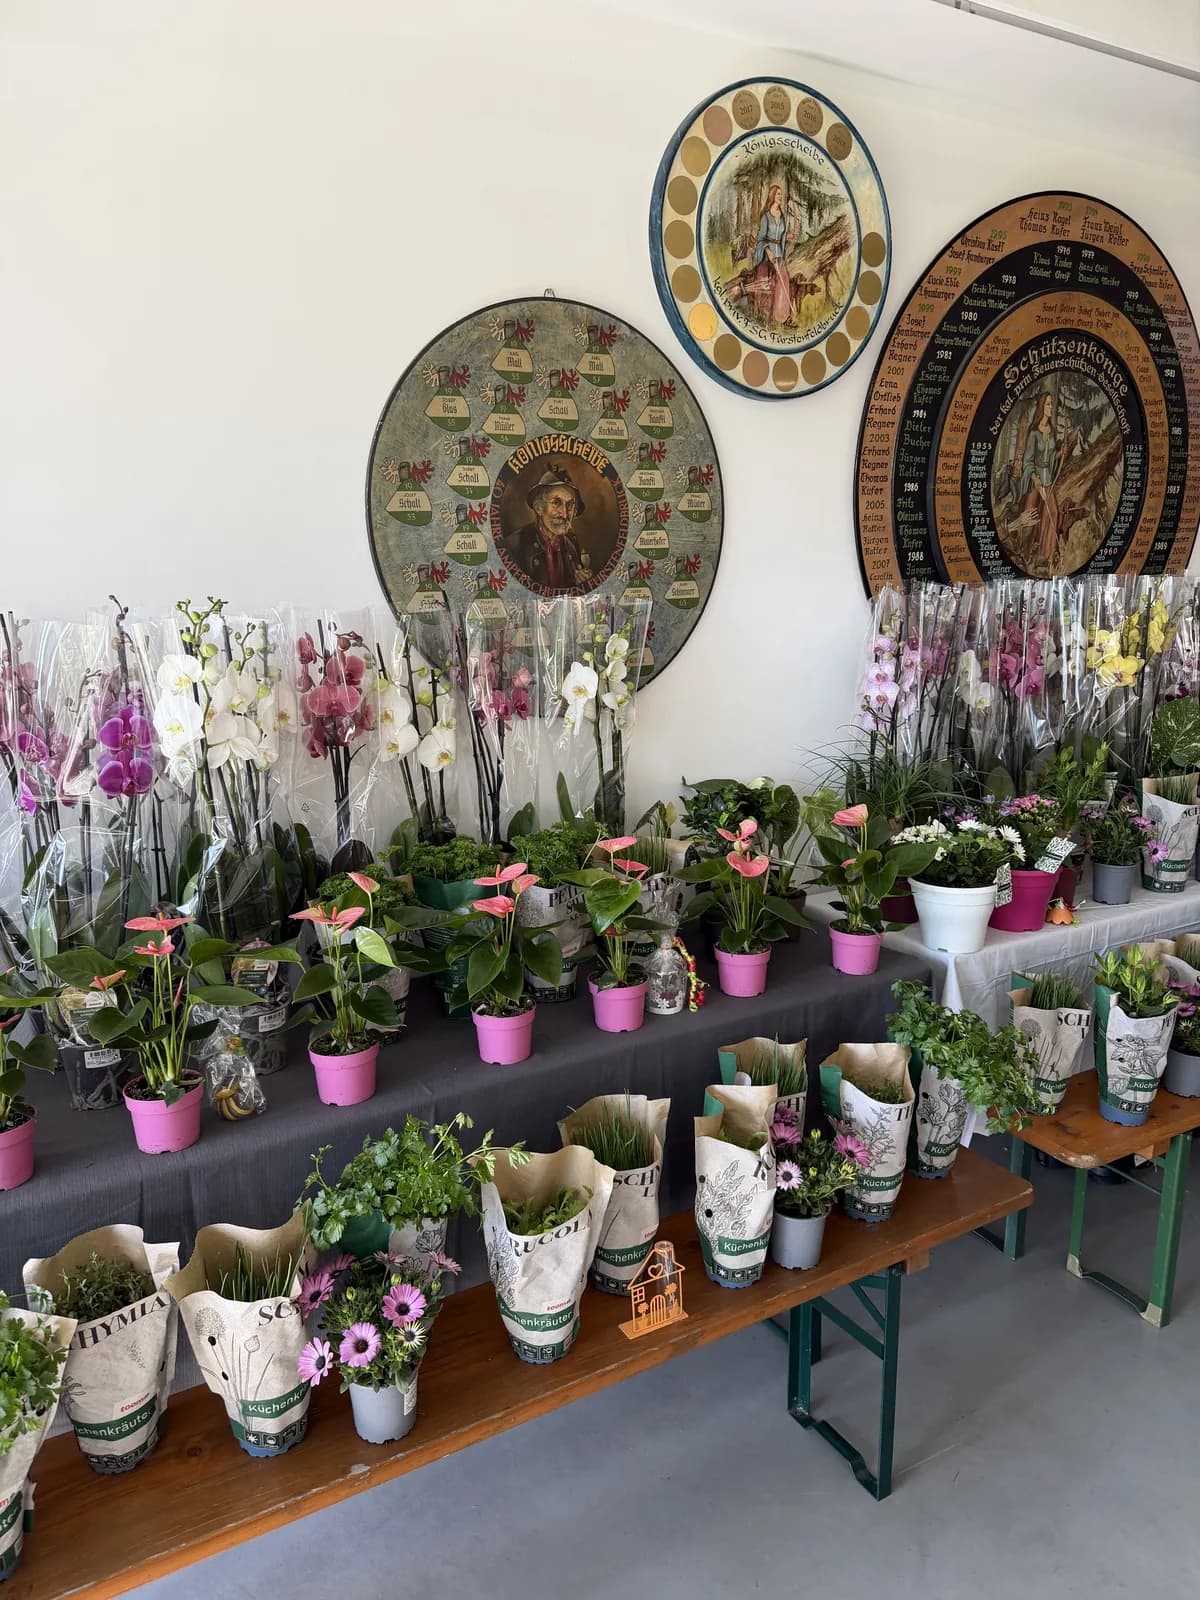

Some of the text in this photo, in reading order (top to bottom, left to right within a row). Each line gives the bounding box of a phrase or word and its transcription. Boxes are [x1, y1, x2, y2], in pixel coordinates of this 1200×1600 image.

[741, 134, 825, 166] Königsscheibe
[1019, 217, 1047, 233] Thomas
[961, 311, 978, 321] 1980
[936, 350, 953, 360] 1982
[887, 366, 904, 376] 2001
[1004, 336, 1128, 397] Schützenkönige
[869, 404, 897, 416] Erhard
[866, 417, 895, 429] Regner
[870, 434, 890, 443] 2003
[862, 446, 890, 459] Erhard
[861, 459, 889, 471] Regner
[860, 472, 889, 484] Thomas
[865, 500, 885, 510] 2005
[899, 524, 927, 537] Thomas
[456, 540, 477, 550] Schall
[863, 536, 889, 546] Jürgen
[907, 551, 924, 561] 1988
[509, 1208, 592, 1257] RUCOL
